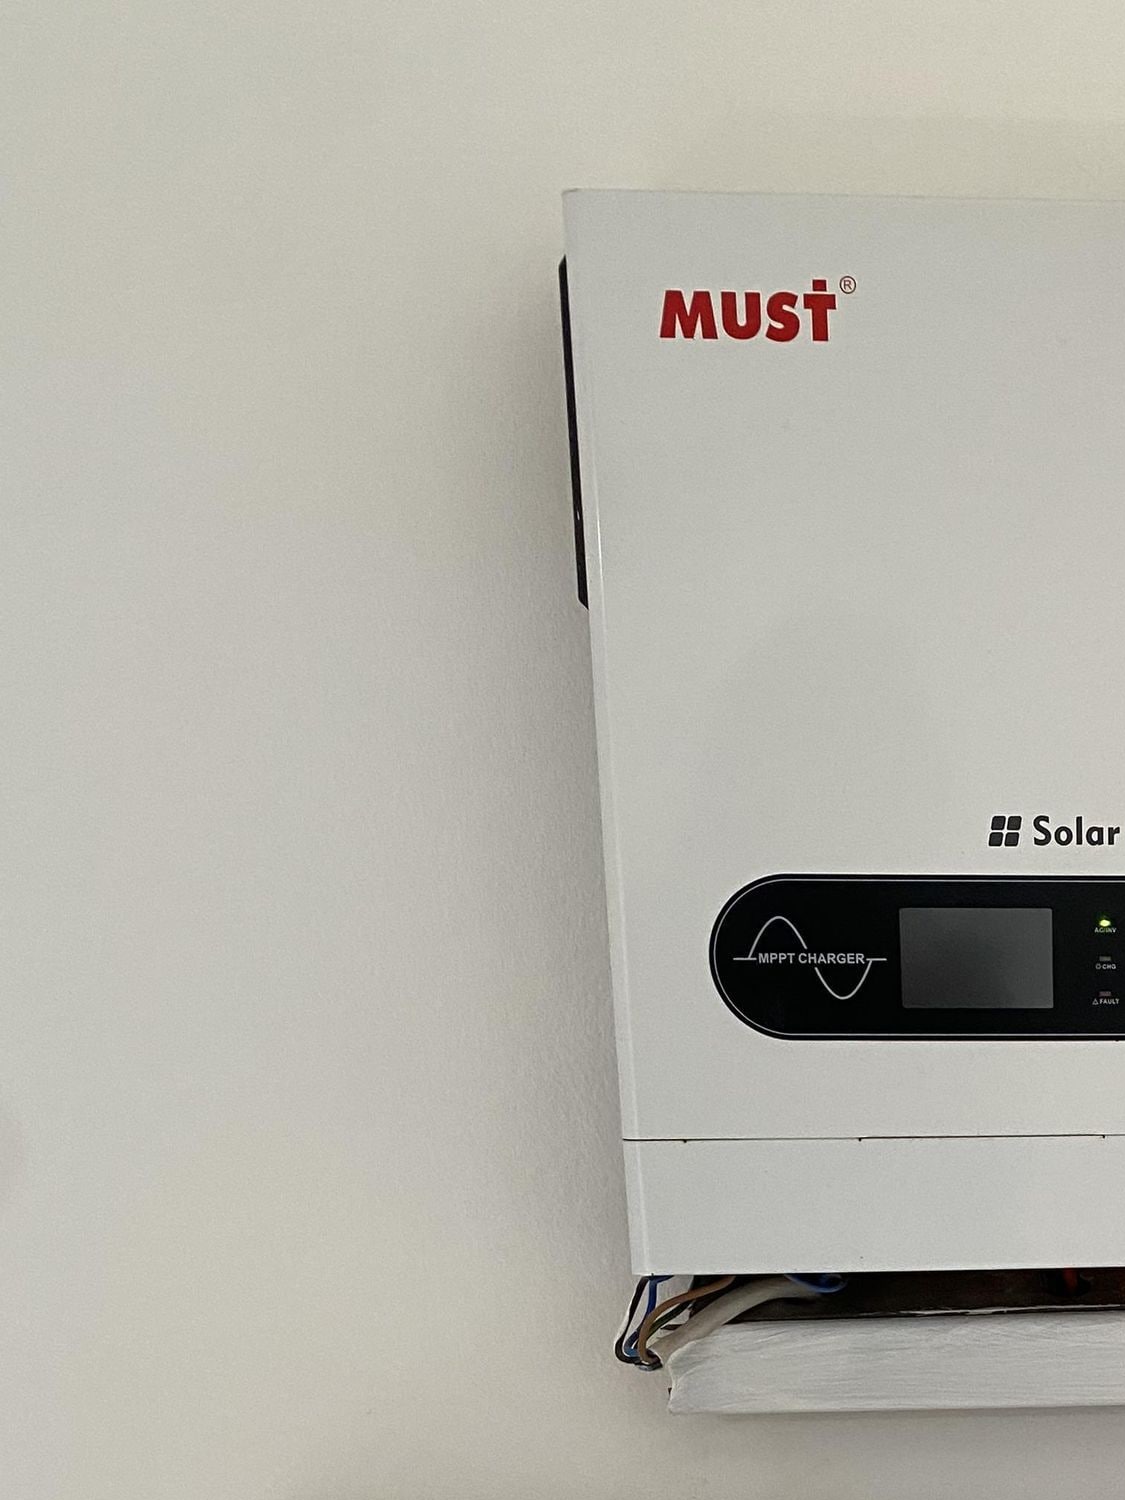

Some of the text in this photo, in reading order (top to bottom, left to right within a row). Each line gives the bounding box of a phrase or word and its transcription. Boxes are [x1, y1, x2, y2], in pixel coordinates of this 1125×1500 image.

[659, 279, 837, 343] MUST
[1032, 814, 1121, 847] Solar
[758, 952, 866, 965] MPPT CHARGER
